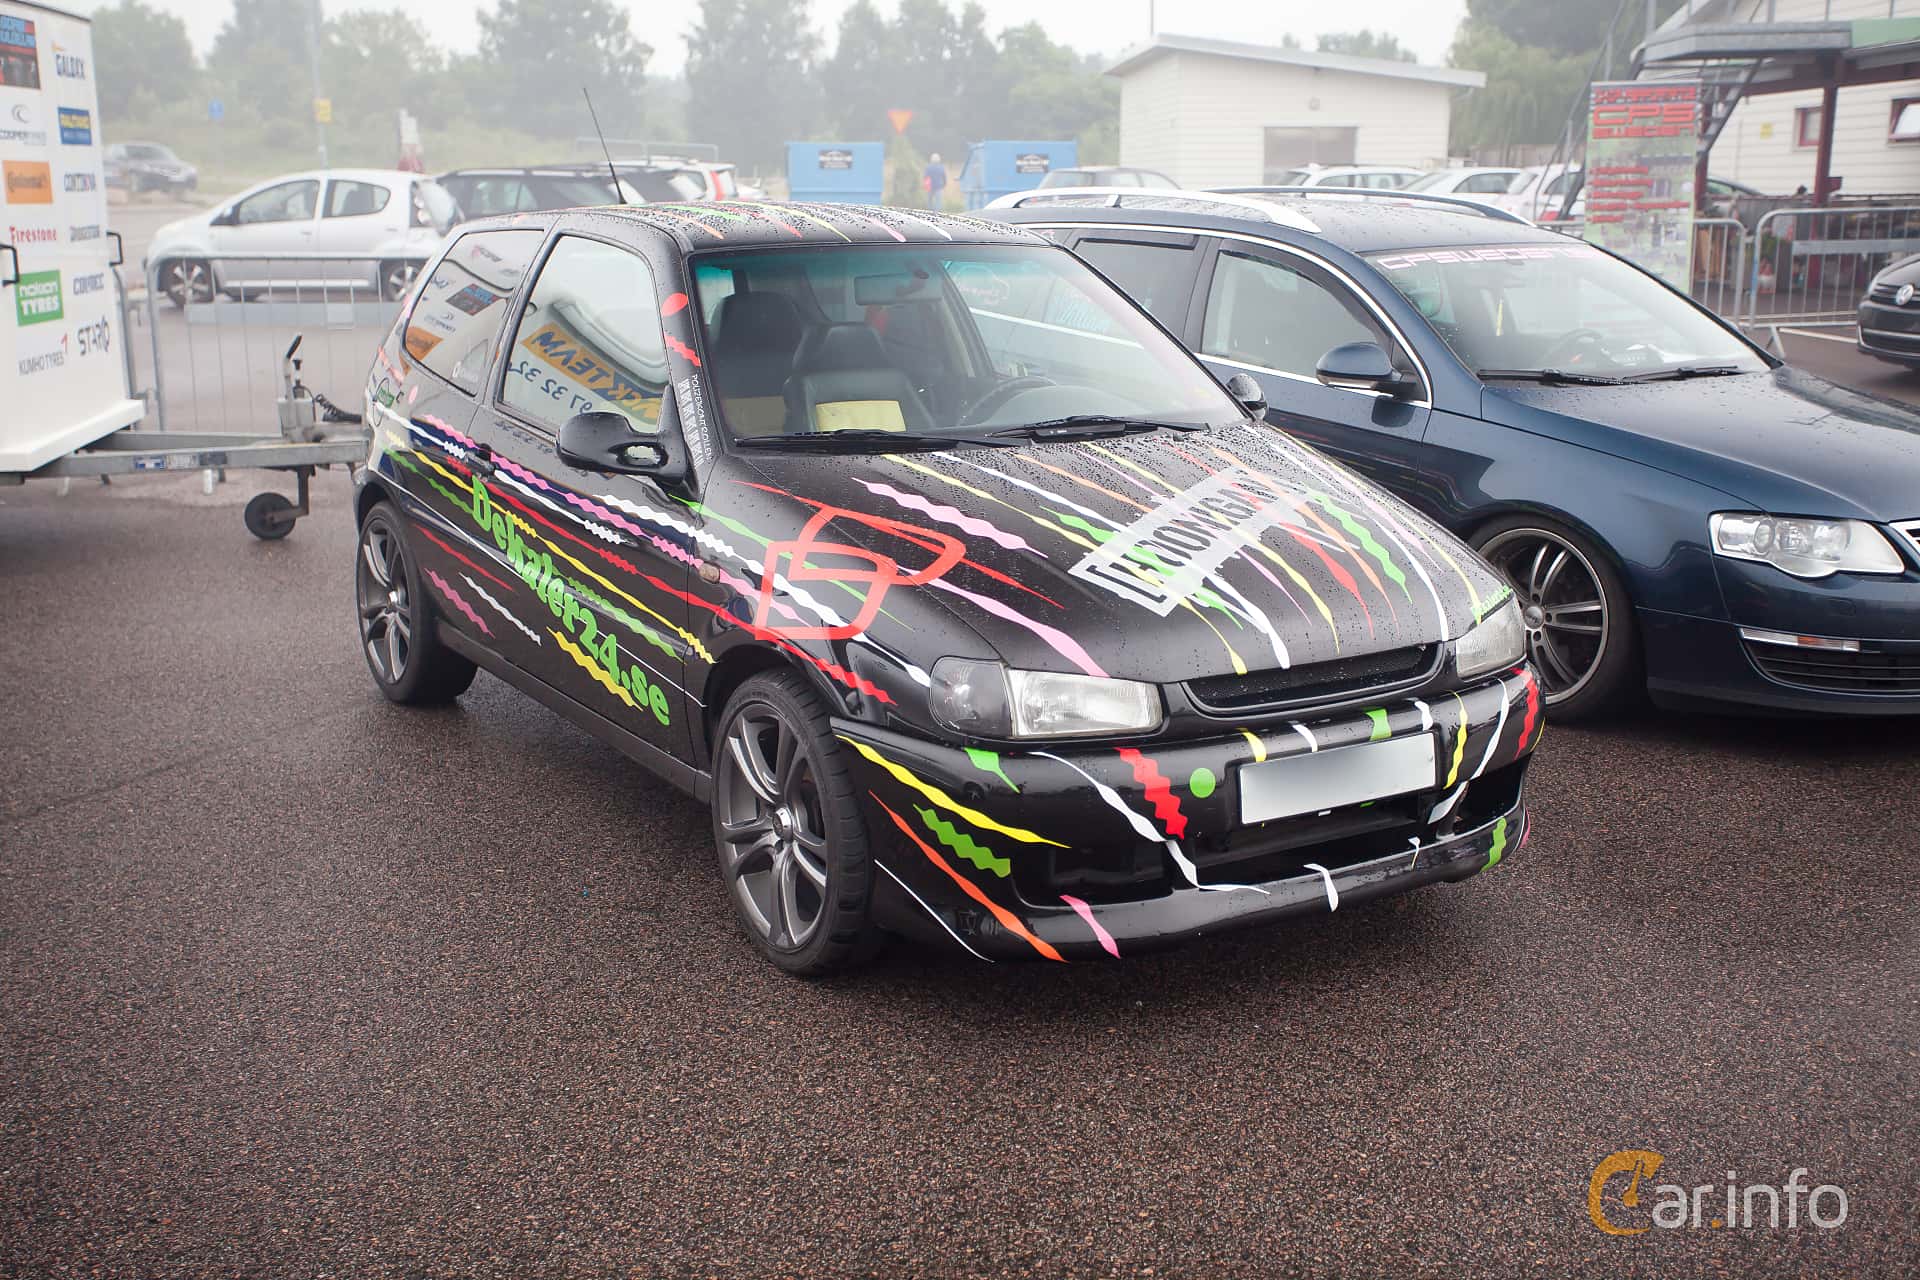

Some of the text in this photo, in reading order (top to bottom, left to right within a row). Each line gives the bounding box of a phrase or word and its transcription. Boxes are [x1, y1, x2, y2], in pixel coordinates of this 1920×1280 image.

[1592, 104, 1695, 125] CPS
[9, 225, 57, 244] Firestone
[471, 475, 671, 726] Dekaler24.se
